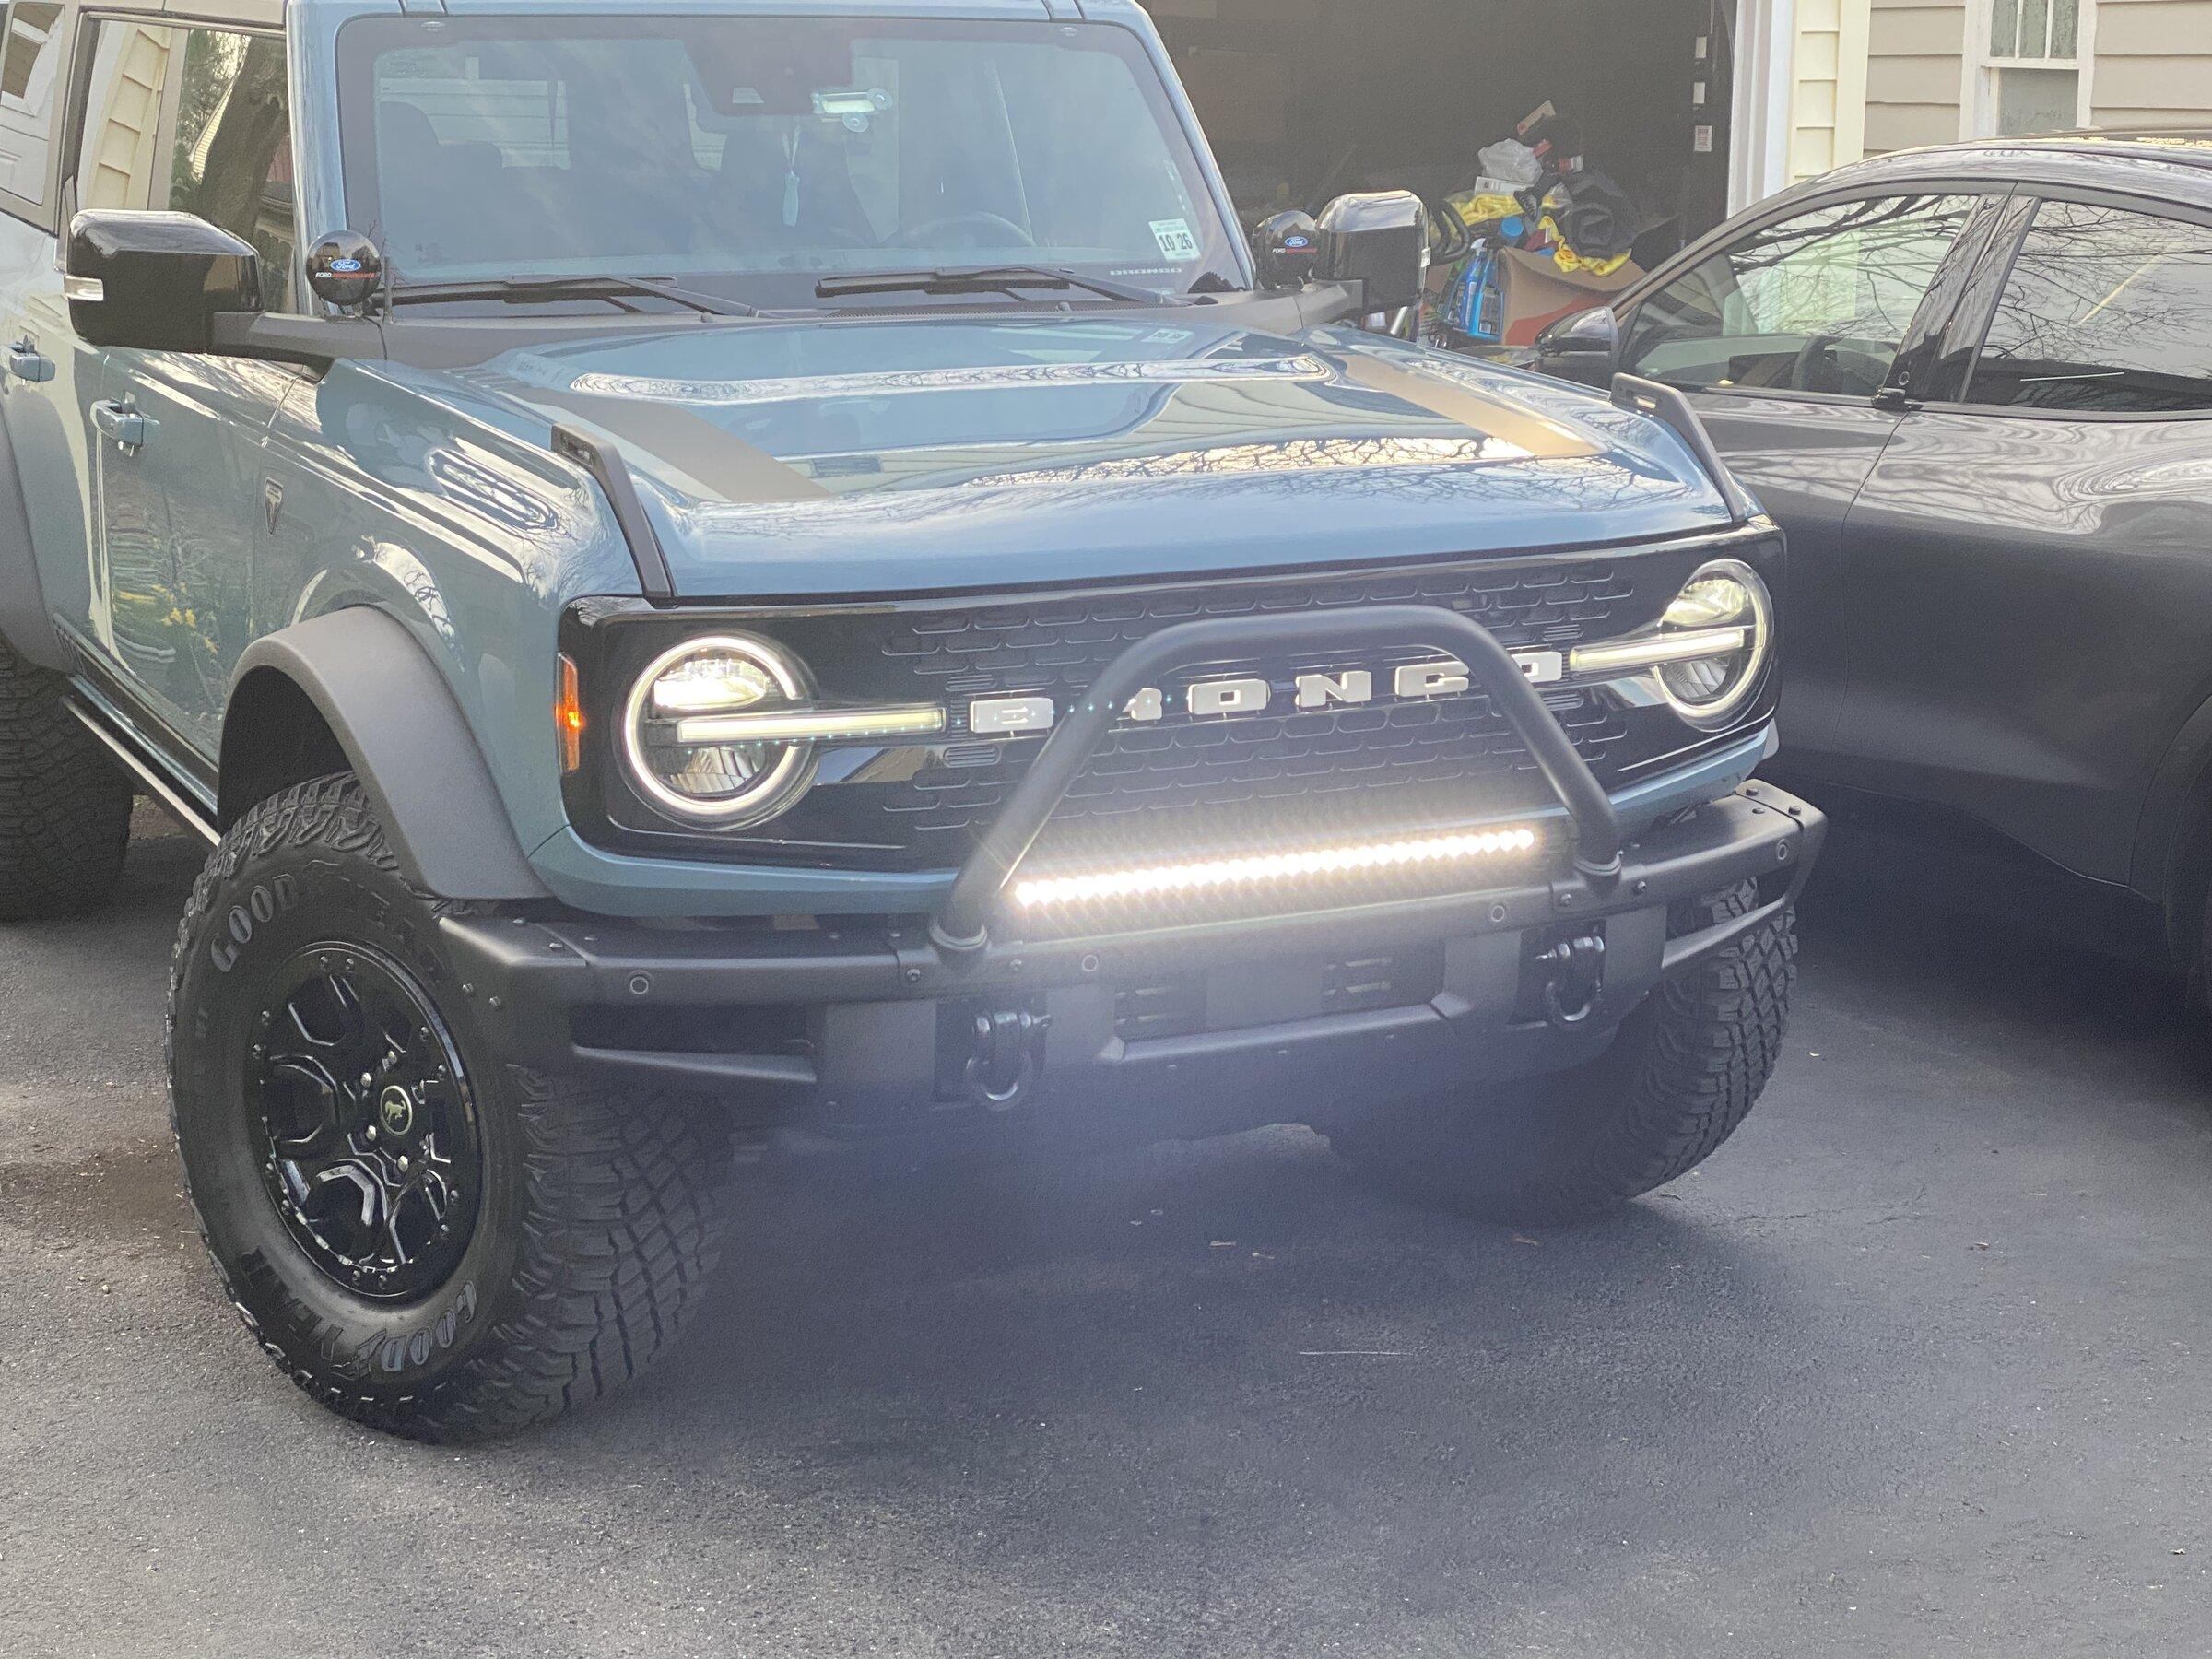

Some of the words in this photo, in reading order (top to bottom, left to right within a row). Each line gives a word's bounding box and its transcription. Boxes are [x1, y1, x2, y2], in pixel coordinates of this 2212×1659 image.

[1159, 234, 1176, 252] 10
[1177, 232, 1193, 250] 26
[335, 260, 356, 270] Ford
